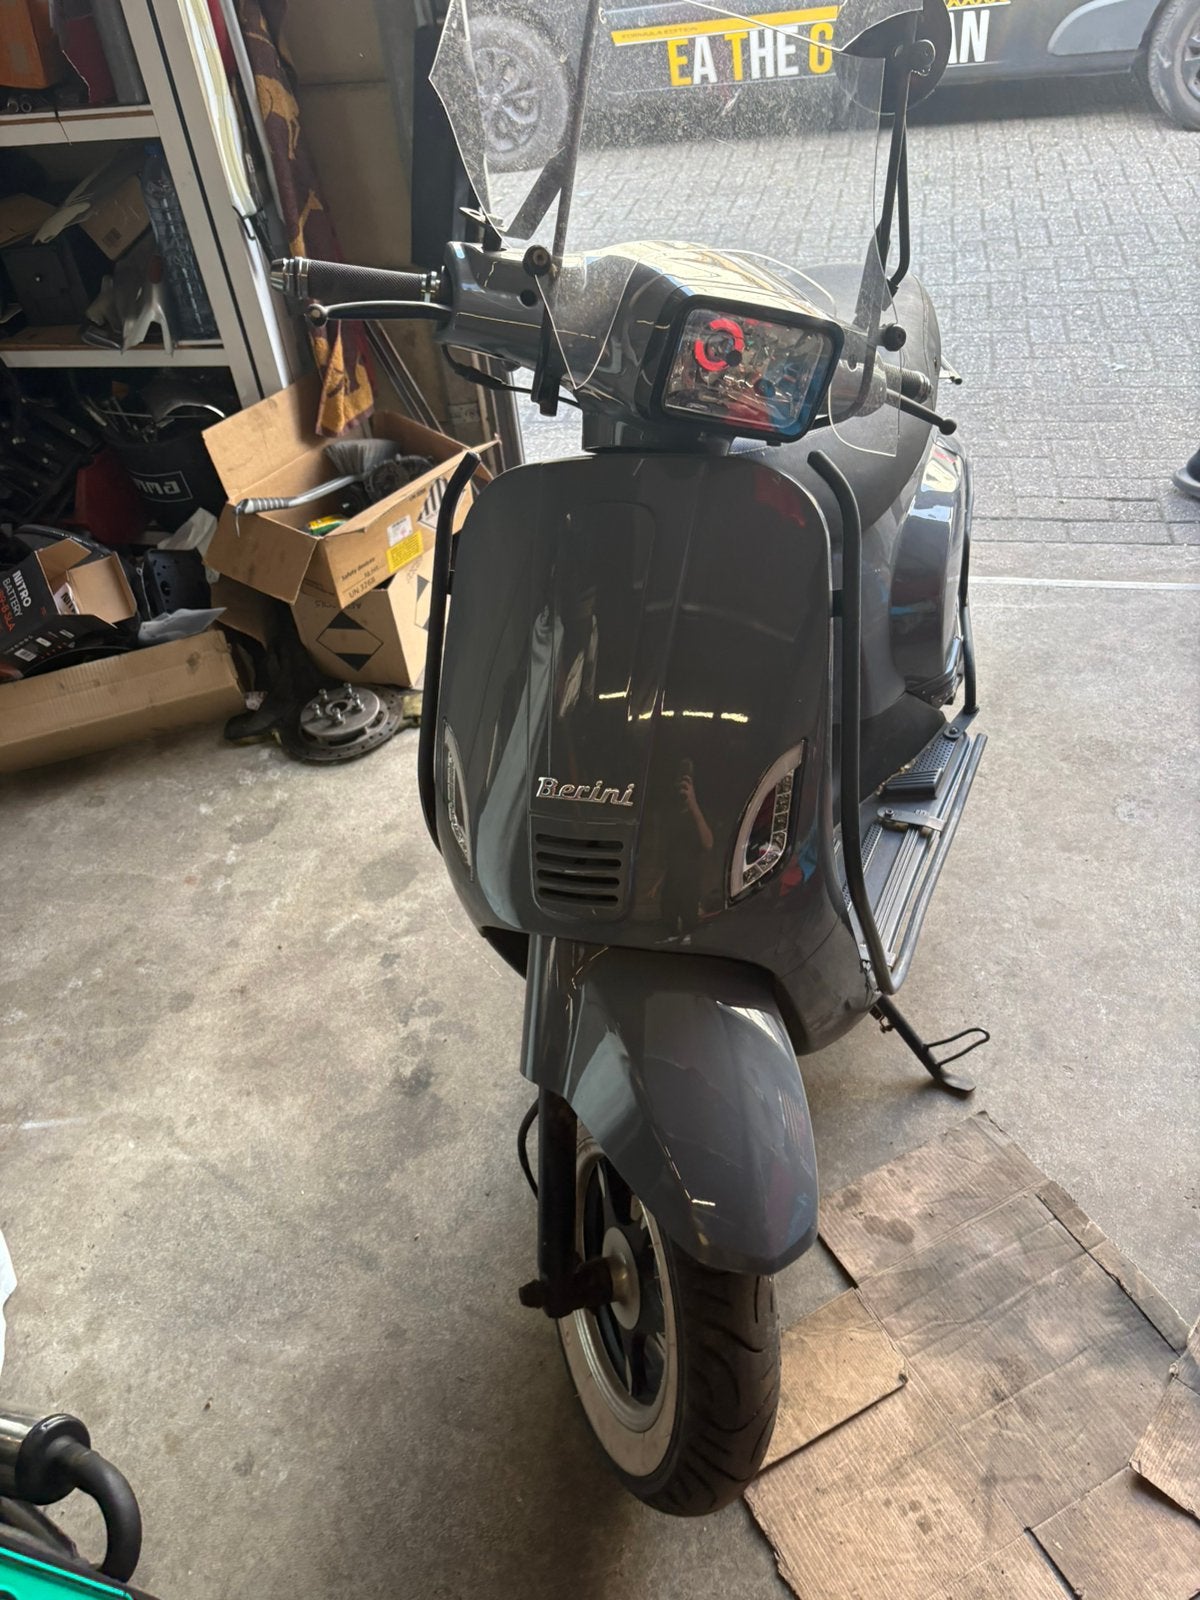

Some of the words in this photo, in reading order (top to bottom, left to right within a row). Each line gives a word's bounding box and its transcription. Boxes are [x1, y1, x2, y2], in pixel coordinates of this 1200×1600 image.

[667, 36, 718, 87] EA
[724, 25, 800, 82] THE
[2, 577, 23, 617] BATTERY
[12, 570, 32, 608] NITRO
[536, 776, 635, 807] Berini
